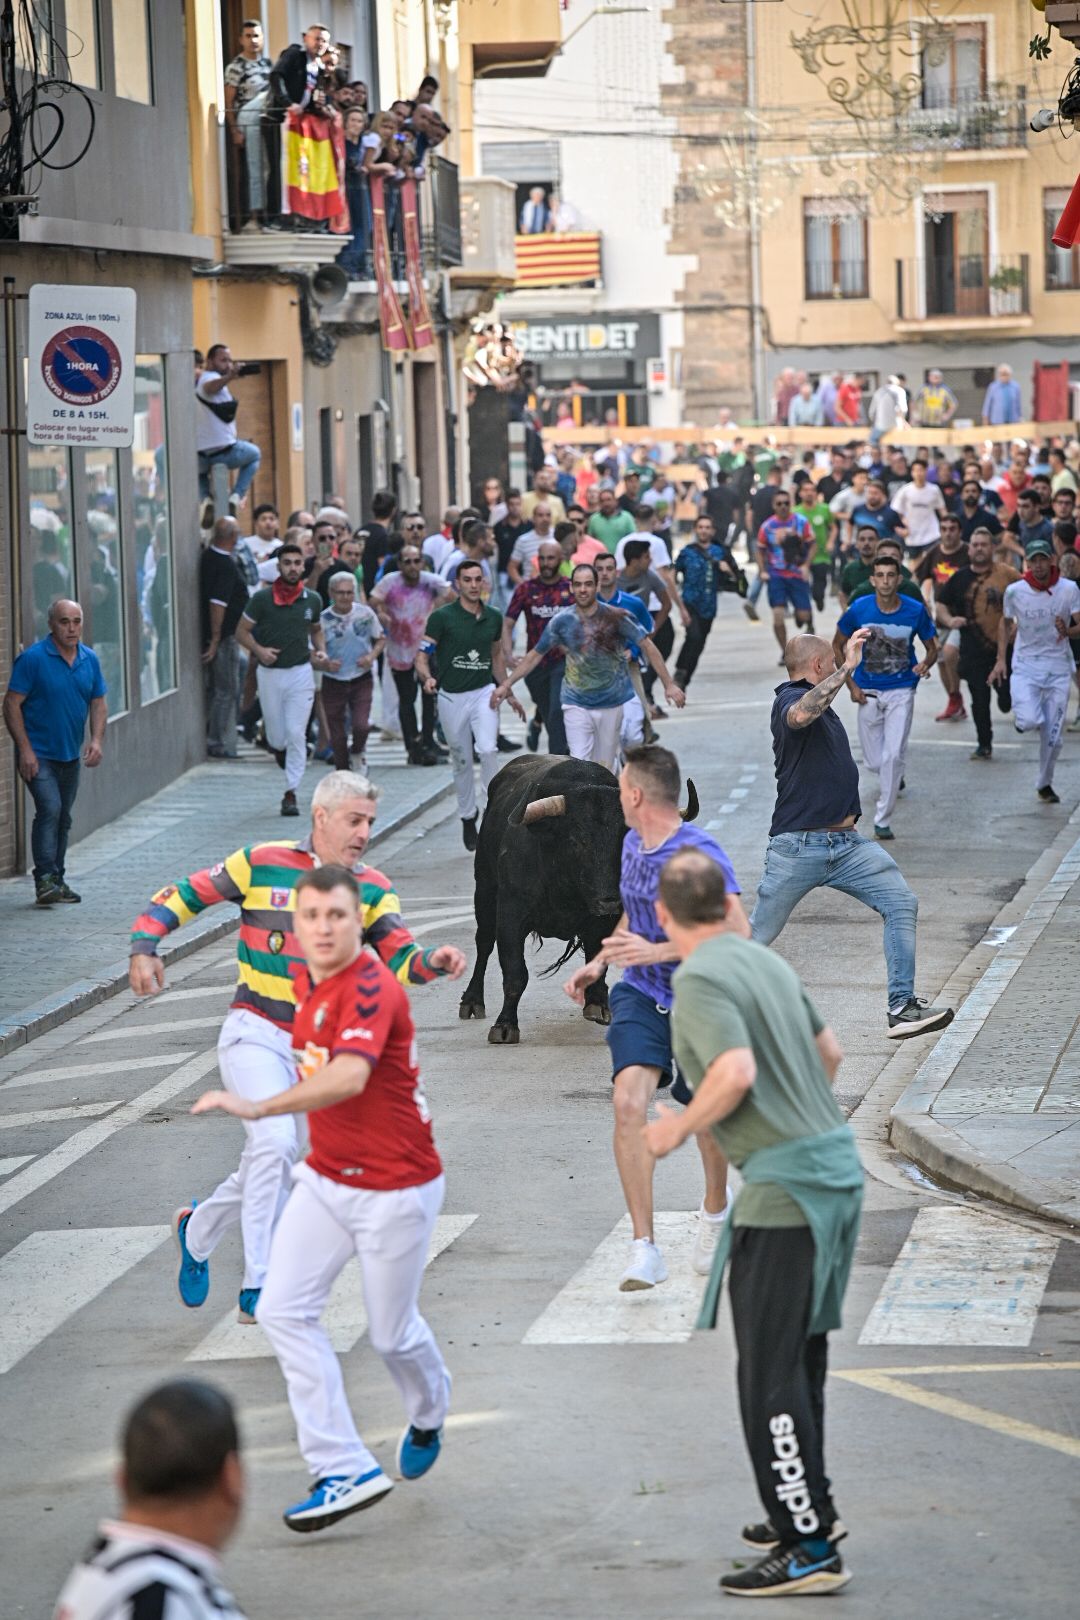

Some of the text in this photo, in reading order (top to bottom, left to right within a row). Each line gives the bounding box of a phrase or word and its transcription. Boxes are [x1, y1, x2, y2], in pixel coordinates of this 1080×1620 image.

[44, 312, 64, 320] ZONA
[66, 313, 84, 321] AZUL
[85, 313, 97, 322] (en
[514, 323, 639, 351] SENTIDET
[52, 409, 110, 420] DE 8 A 15H.
[33, 423, 65, 432] Colocar
[79, 424, 100, 434] lugar
[101, 425, 129, 434] visible
[33, 432, 98, 442] hora de llegada.
[769, 1413, 819, 1534] adidas
